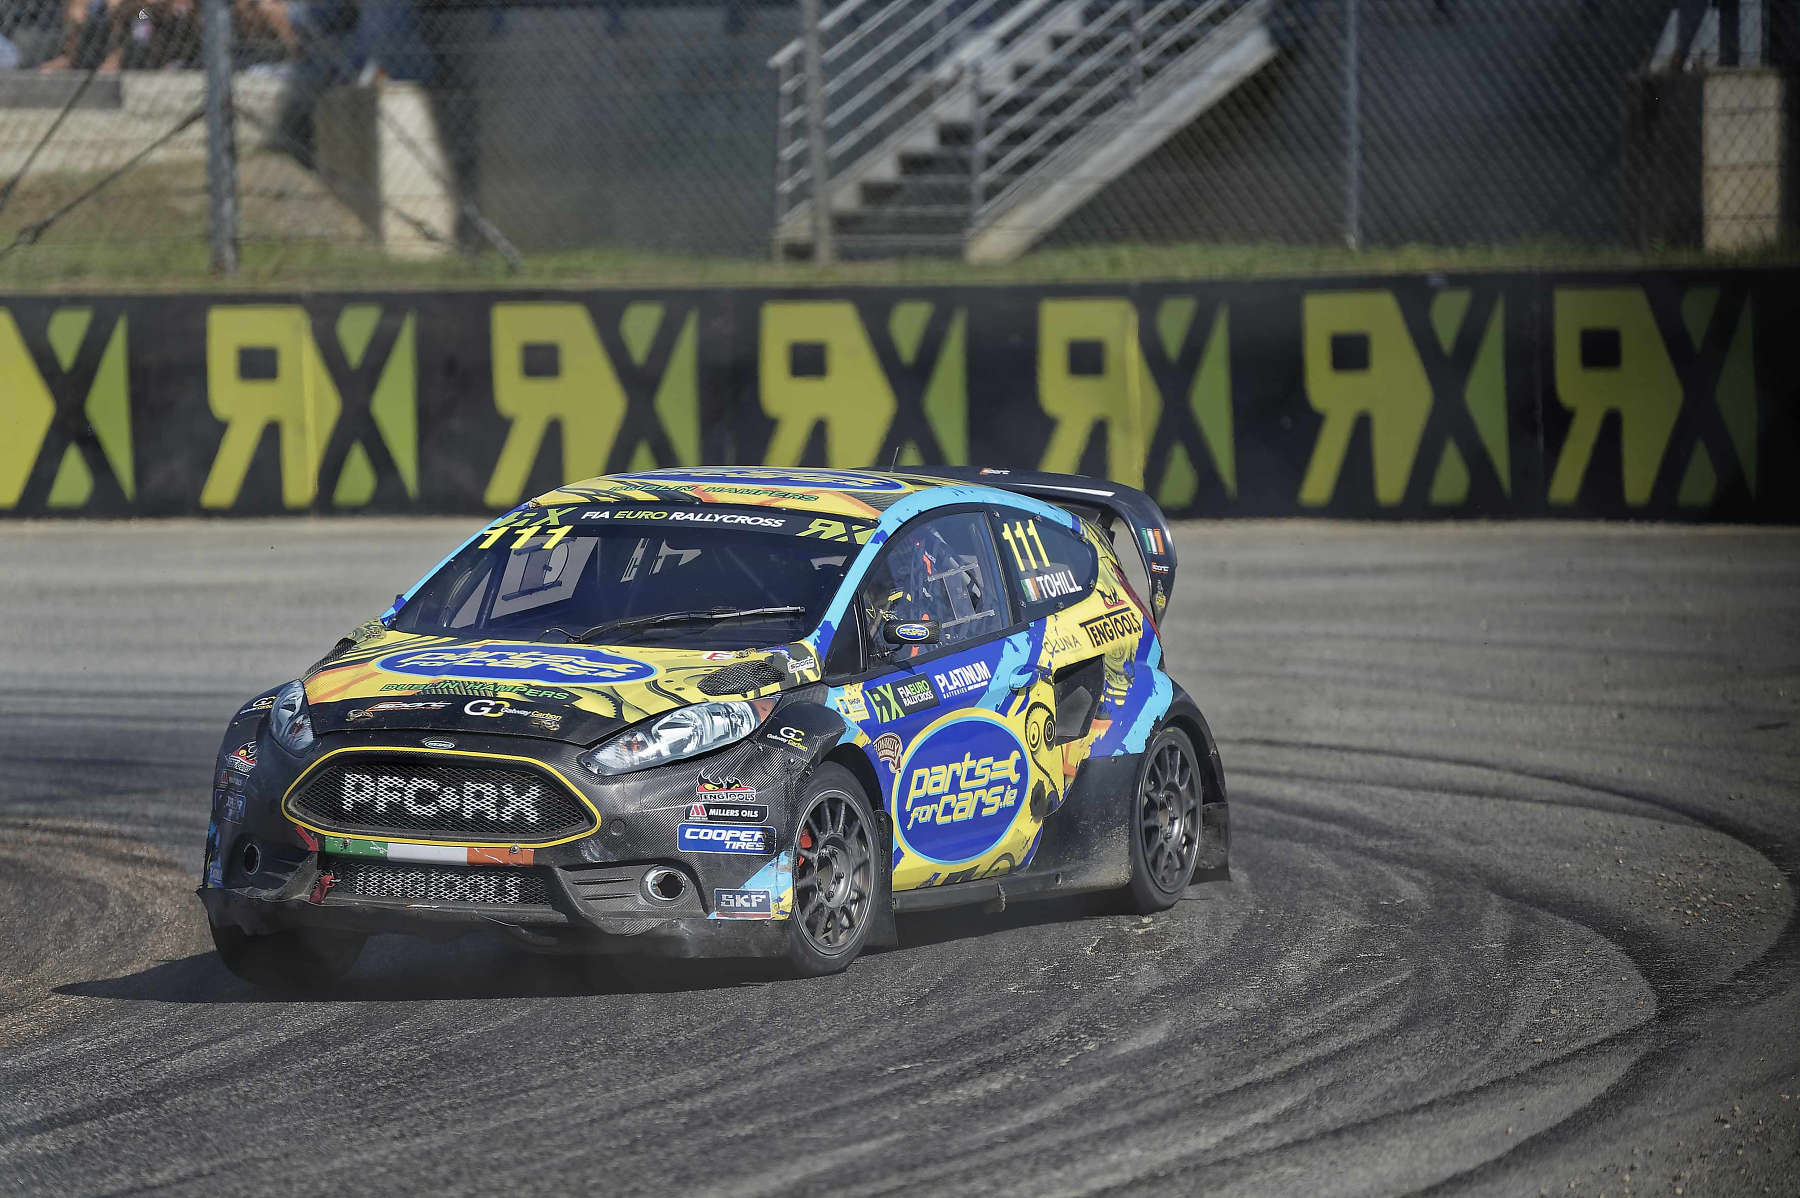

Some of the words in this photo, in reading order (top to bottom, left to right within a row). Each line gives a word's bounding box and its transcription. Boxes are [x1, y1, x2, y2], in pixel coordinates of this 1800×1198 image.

[581, 511, 611, 520] FIA
[613, 510, 668, 520] EURO
[668, 511, 787, 528] RALLYCROSS
[478, 525, 574, 549] 111
[1002, 519, 1051, 572] 111
[1035, 569, 1083, 599] TOHILL
[934, 660, 992, 694] PLATINUM
[380, 680, 459, 692] DUBLIN
[466, 681, 569, 701] HAMPERS
[902, 690, 934, 707] RALLYCROSS
[500, 707, 532, 717] Galway
[530, 710, 563, 721] Carbon
[905, 752, 994, 812] parts
[708, 808, 740, 817] MILLERS
[740, 810, 759, 818] OILS
[907, 803, 939, 831] for
[685, 827, 765, 842] COOPER
[724, 840, 766, 851] TIRES
[720, 893, 767, 908] SKF
